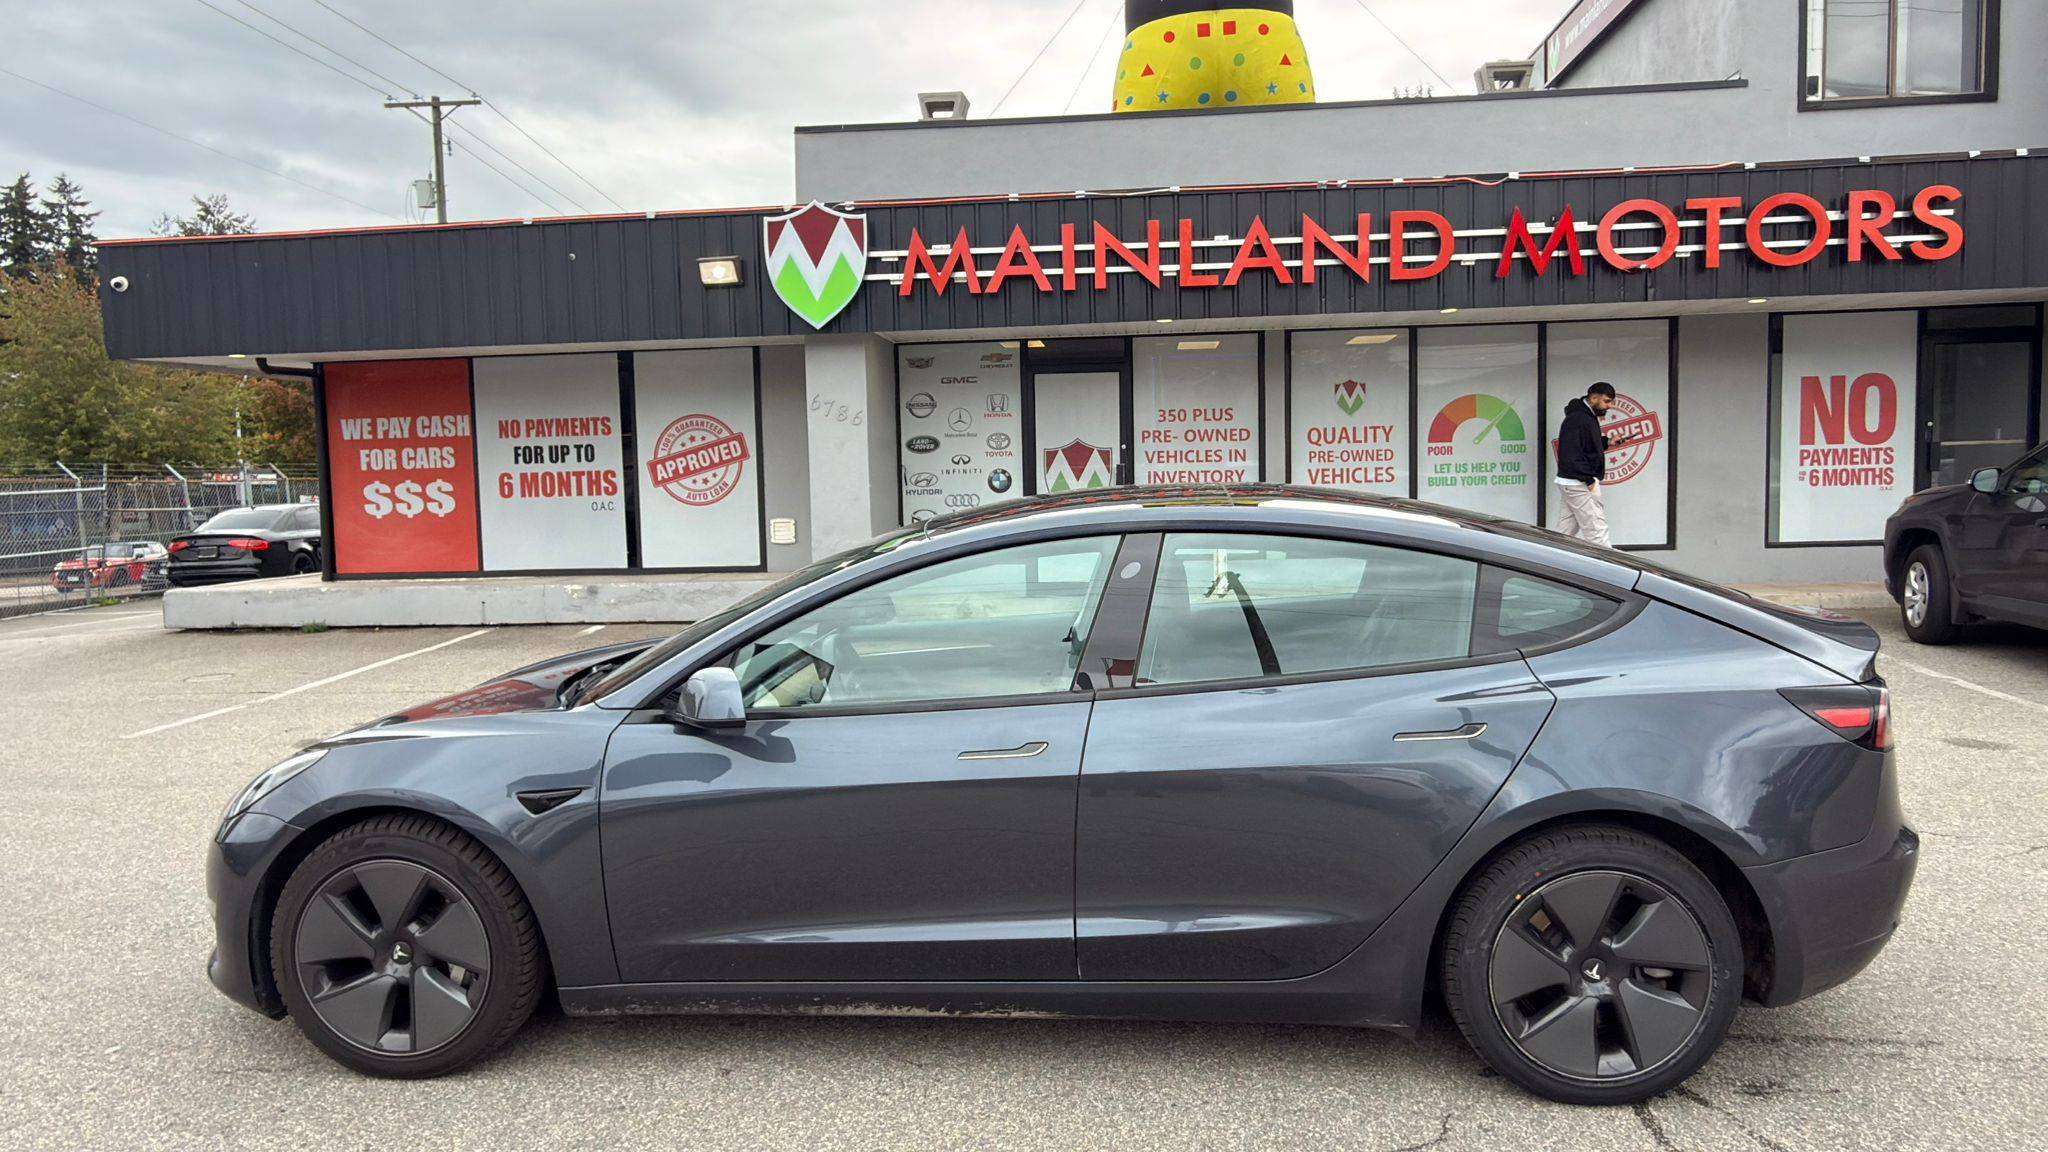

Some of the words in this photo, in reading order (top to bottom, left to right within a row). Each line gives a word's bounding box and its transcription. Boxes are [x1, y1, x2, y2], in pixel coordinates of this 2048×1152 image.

[899, 210, 1455, 297] MAINLAND
[1496, 184, 1964, 278] MOTORS
[941, 376, 978, 385] GMC
[810, 393, 864, 426] 6786
[1158, 409, 1187, 423] 350
[1193, 407, 1234, 422] PLUS
[1800, 372, 1897, 446] NO
[340, 418, 373, 440] WE
[376, 416, 412, 439] PAY
[416, 414, 471, 438] CASH
[498, 419, 521, 439] NO
[525, 415, 612, 438] PAYMENTS
[675, 419, 724, 435] GUARANTEED
[1141, 430, 1178, 443] PRE-
[1183, 428, 1251, 443] OWNED
[1307, 425, 1394, 447] QUALITY
[360, 448, 397, 471] FOR
[401, 446, 456, 470] CARS
[514, 446, 545, 464] FOR
[548, 445, 570, 463] UP
[574, 444, 595, 463] TO
[1145, 449, 1223, 463] VEHICLES
[1229, 449, 1247, 462] IN
[1308, 449, 1394, 463] PRE-OWNED
[1427, 446, 1454, 456] POOR
[1500, 444, 1527, 454] GOOD
[1800, 447, 1895, 466] PAYMENTS
[656, 440, 742, 482] APPROVED
[1434, 463, 1452, 473] LET
[1455, 463, 1468, 473] US
[1471, 463, 1497, 473] HELP
[1500, 462, 1521, 472] YOU
[498, 472, 514, 499] 6
[519, 469, 618, 498] MONTHS
[1147, 469, 1246, 484] INVENTORY
[1307, 467, 1396, 485] VEHICLES
[1427, 476, 1457, 487] BUILD
[1460, 475, 1488, 486] YOUR
[1491, 474, 1527, 485] CREDIT
[1809, 469, 1820, 487] 6
[1822, 467, 1895, 487] MONTHS
[363, 479, 456, 519] $$$
[686, 491, 708, 501] AUTO
[710, 480, 730, 498] LOAN
